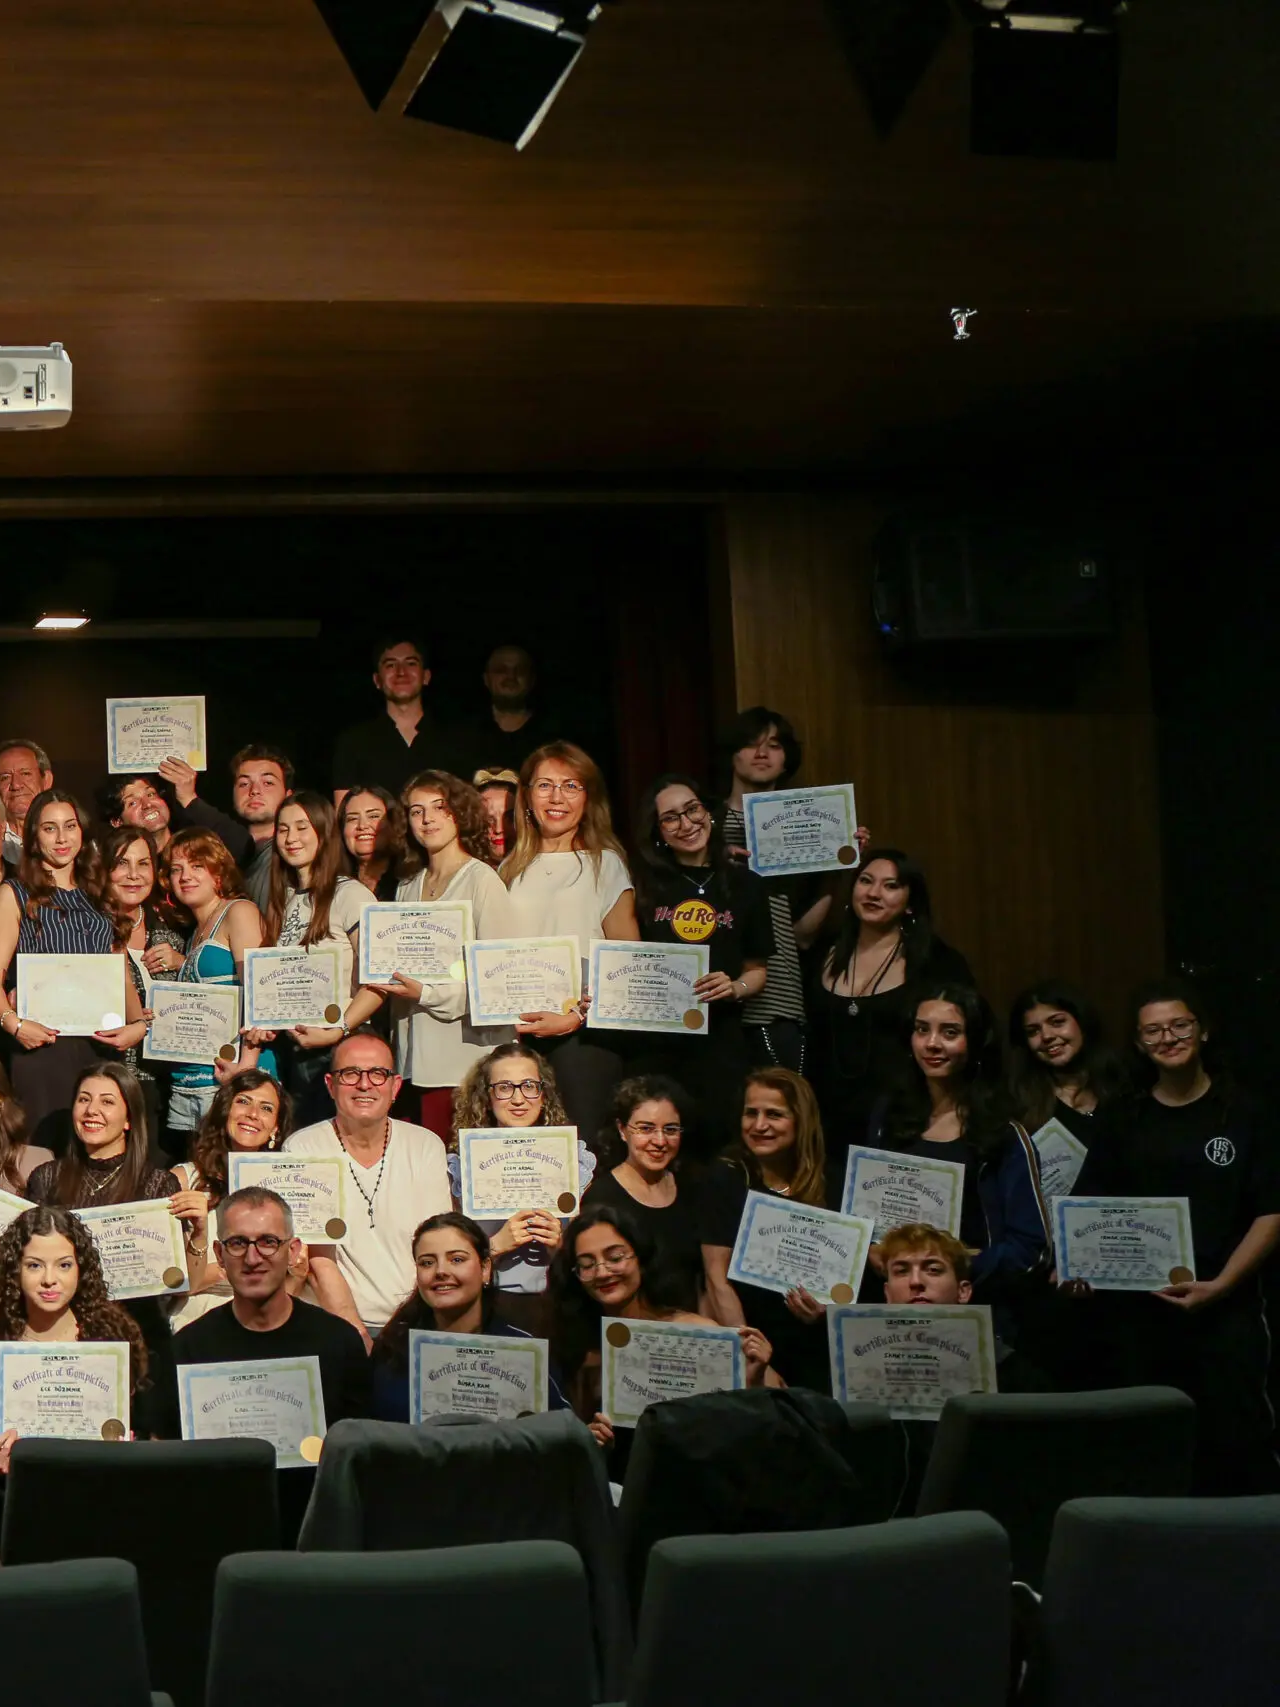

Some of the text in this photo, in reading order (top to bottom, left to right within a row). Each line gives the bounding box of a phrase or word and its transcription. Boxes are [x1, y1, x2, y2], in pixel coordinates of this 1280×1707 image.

[654, 906, 734, 928] Hard Rock
[683, 926, 703, 935] CAFE
